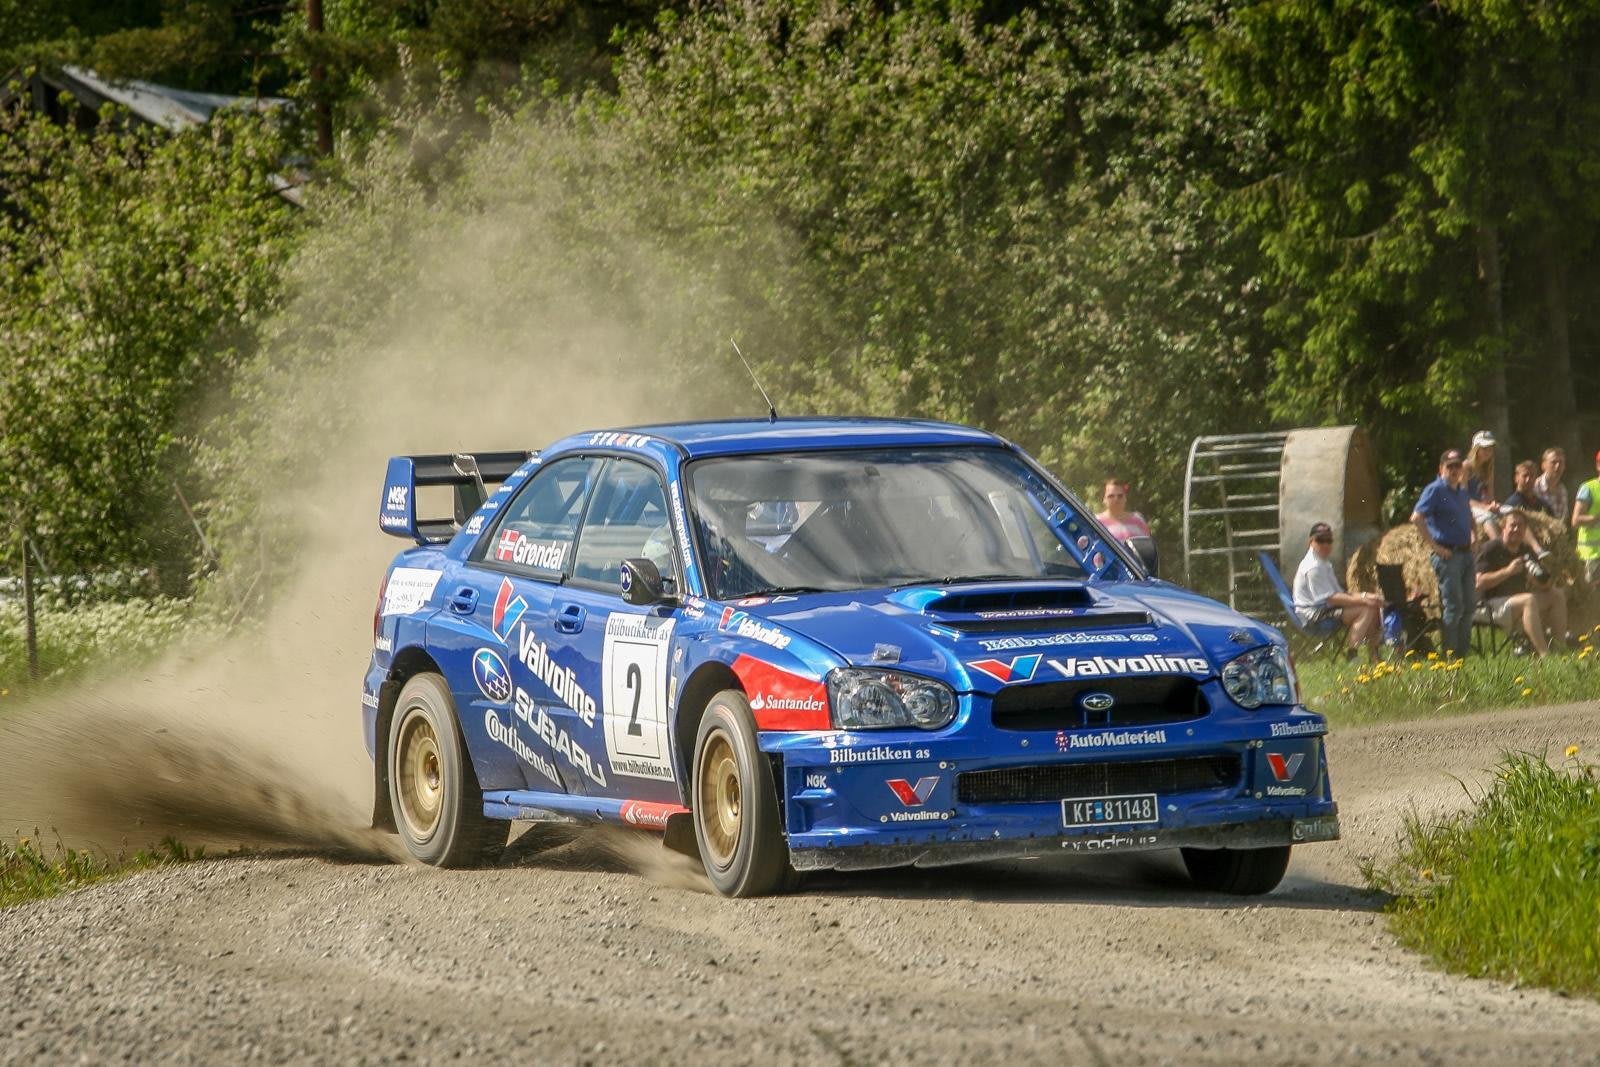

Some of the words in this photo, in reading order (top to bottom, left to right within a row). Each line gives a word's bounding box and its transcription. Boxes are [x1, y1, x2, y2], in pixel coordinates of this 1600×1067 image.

[513, 535, 567, 570] Grøndal
[608, 618, 658, 640] Bilbutikken
[659, 629, 669, 640] as
[737, 617, 792, 650] Valvoline
[979, 632, 1130, 651] Bilbutikken
[1130, 633, 1159, 642] as
[518, 621, 597, 729] Valvoline
[1047, 654, 1210, 678] Valvoline
[626, 662, 643, 737] 2
[766, 695, 825, 712] Santander
[514, 686, 607, 788] SUBARU
[1069, 730, 1167, 748] AutoMateriell
[484, 709, 562, 788] Continental
[830, 746, 912, 763] Bilbutikken
[915, 748, 931, 759] as
[612, 760, 673, 778] www.bilbutikken.no
[806, 774, 828, 788] NGK
[1267, 786, 1307, 796] Valvoline
[890, 811, 940, 822] Valvoline
[1073, 802, 1093, 823] KF
[1104, 799, 1152, 821] 81148
